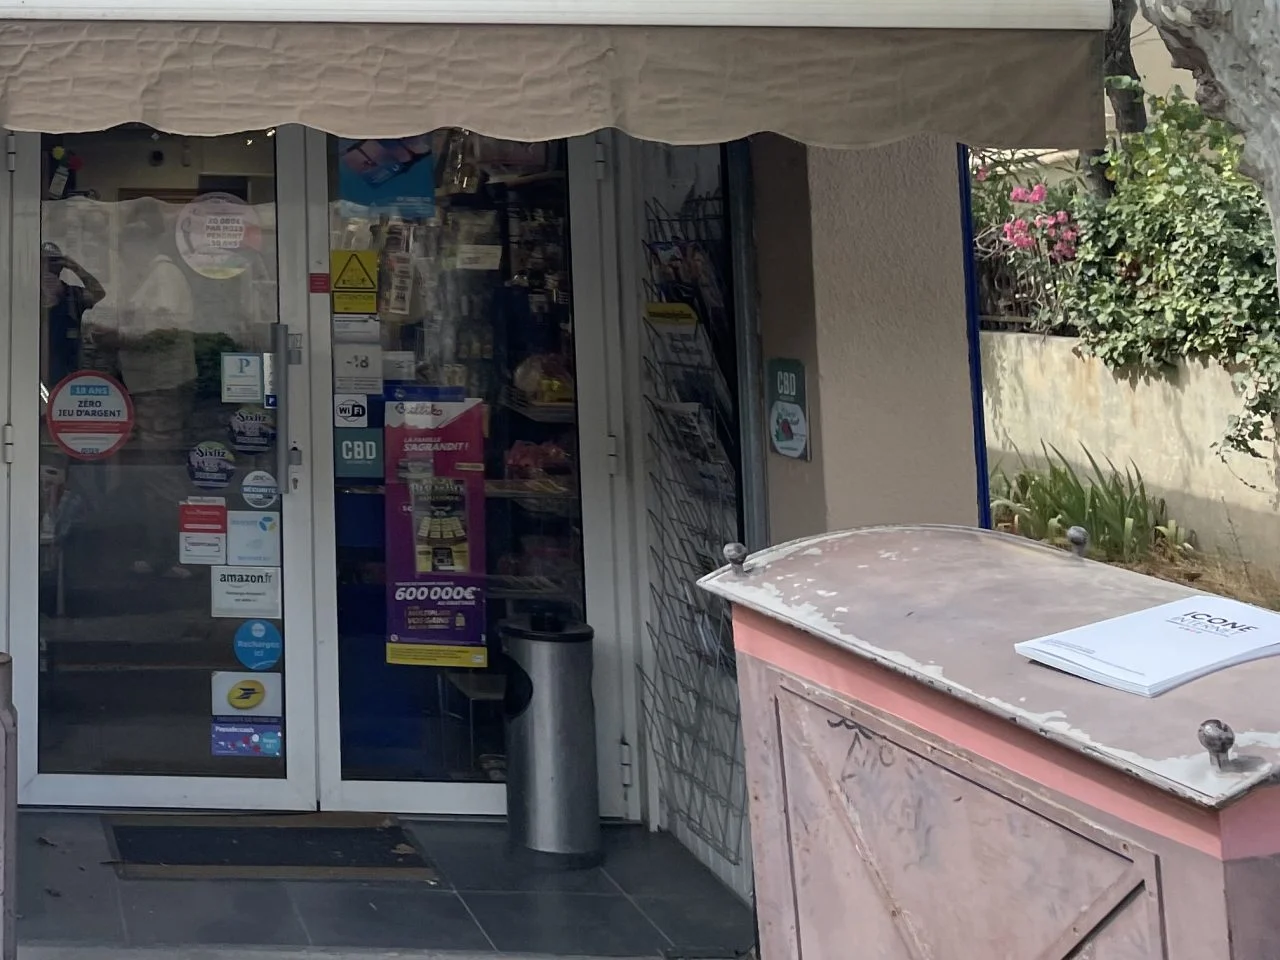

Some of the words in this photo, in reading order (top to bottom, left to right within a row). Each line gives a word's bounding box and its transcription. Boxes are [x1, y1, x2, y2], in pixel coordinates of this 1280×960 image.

[777, 370, 797, 396] CBD
[58, 409, 75, 417] JEU
[76, 409, 121, 418] D'ARGENT
[341, 440, 377, 460] CBD
[403, 441, 464, 452] S'AGRANDIT
[219, 572, 272, 584] amazon.fr
[395, 587, 429, 601] 600
[1183, 611, 1259, 632] ICONE
